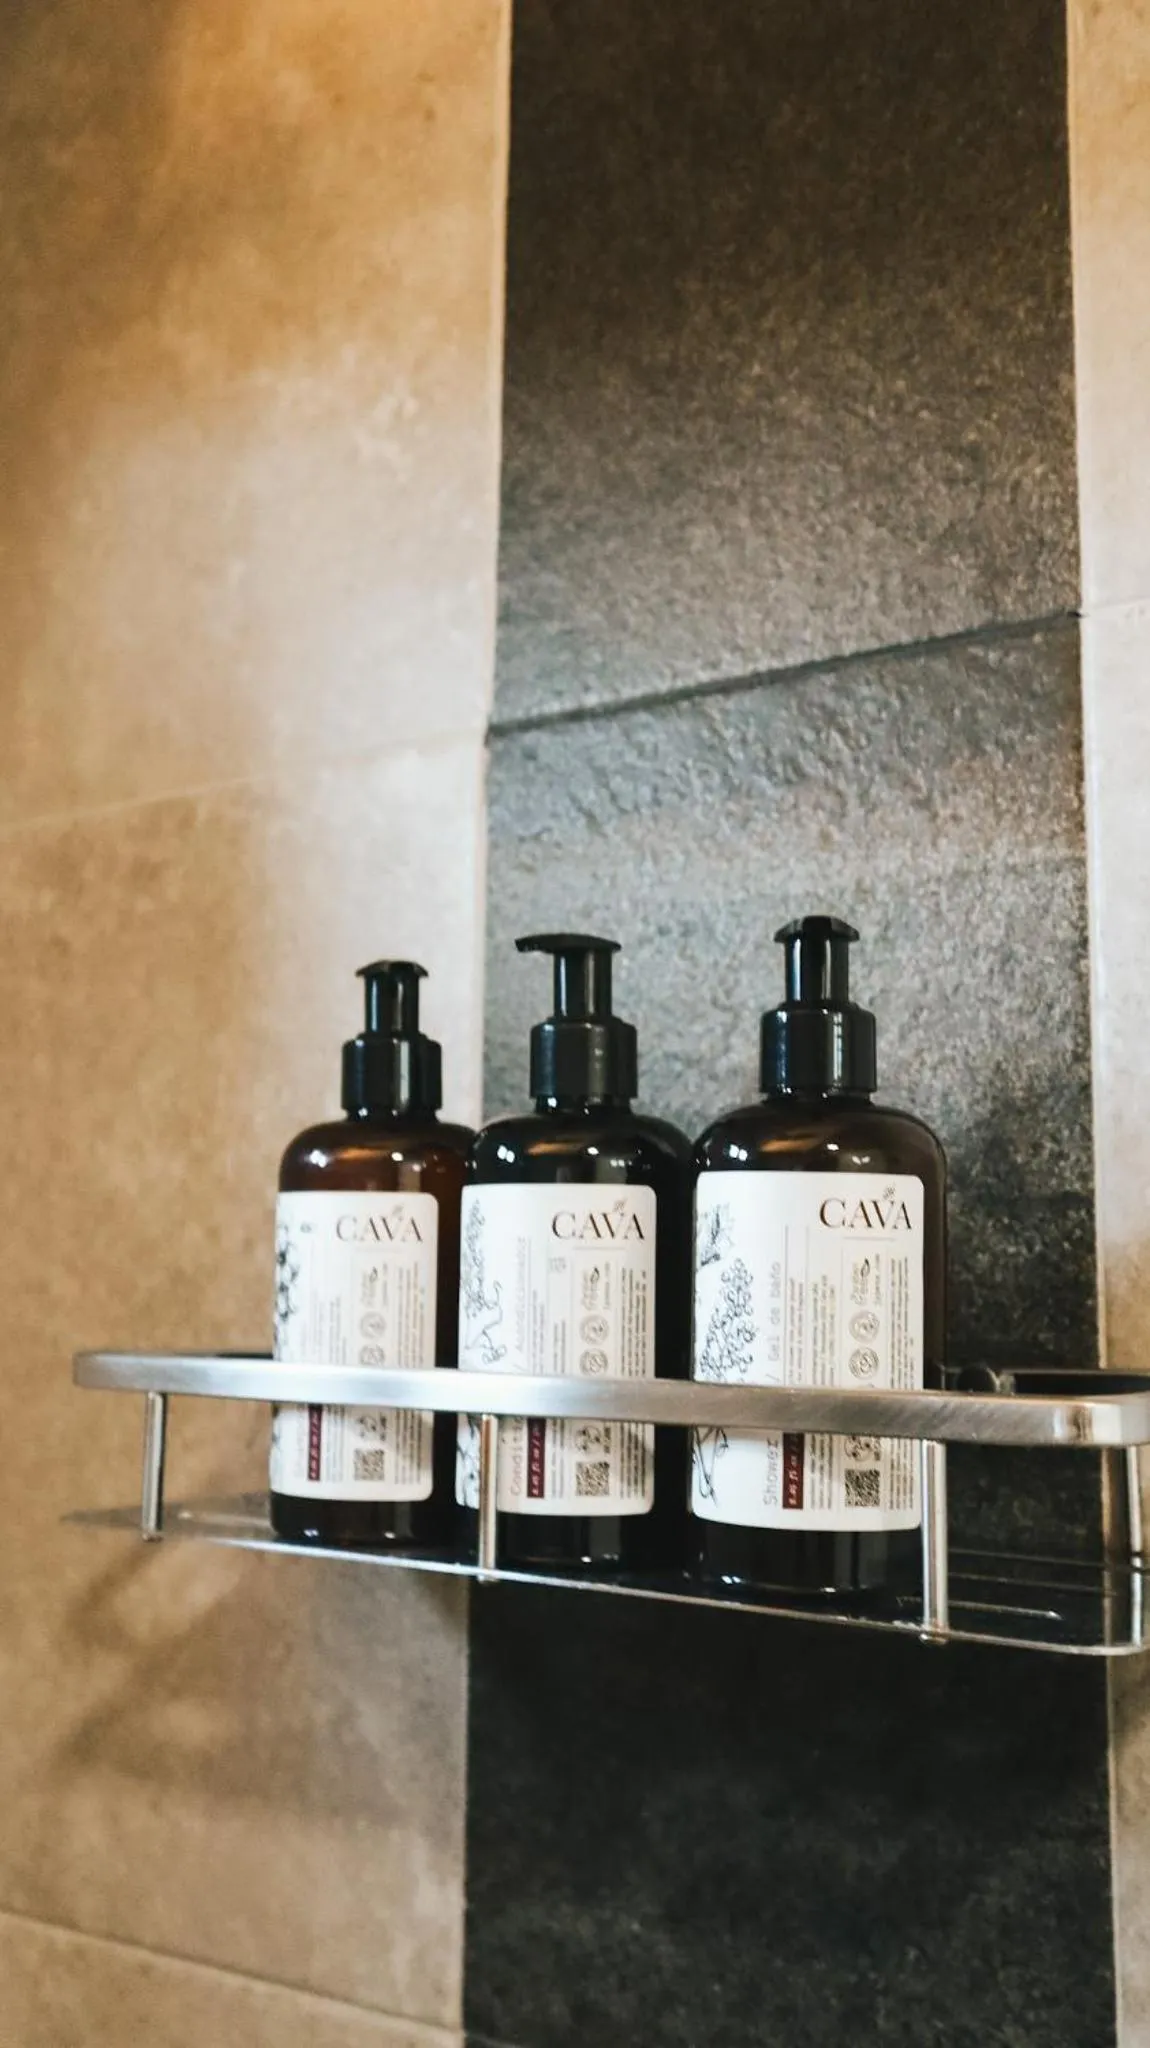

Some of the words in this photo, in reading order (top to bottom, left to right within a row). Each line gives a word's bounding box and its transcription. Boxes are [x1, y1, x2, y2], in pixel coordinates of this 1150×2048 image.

[336, 1214, 424, 1243] CAVA
[552, 1211, 646, 1242] CAVA
[819, 1197, 913, 1231] CAVA
[767, 1307, 781, 1326] de
[767, 1336, 781, 1361] Gel
[762, 1438, 778, 1506] Shower
